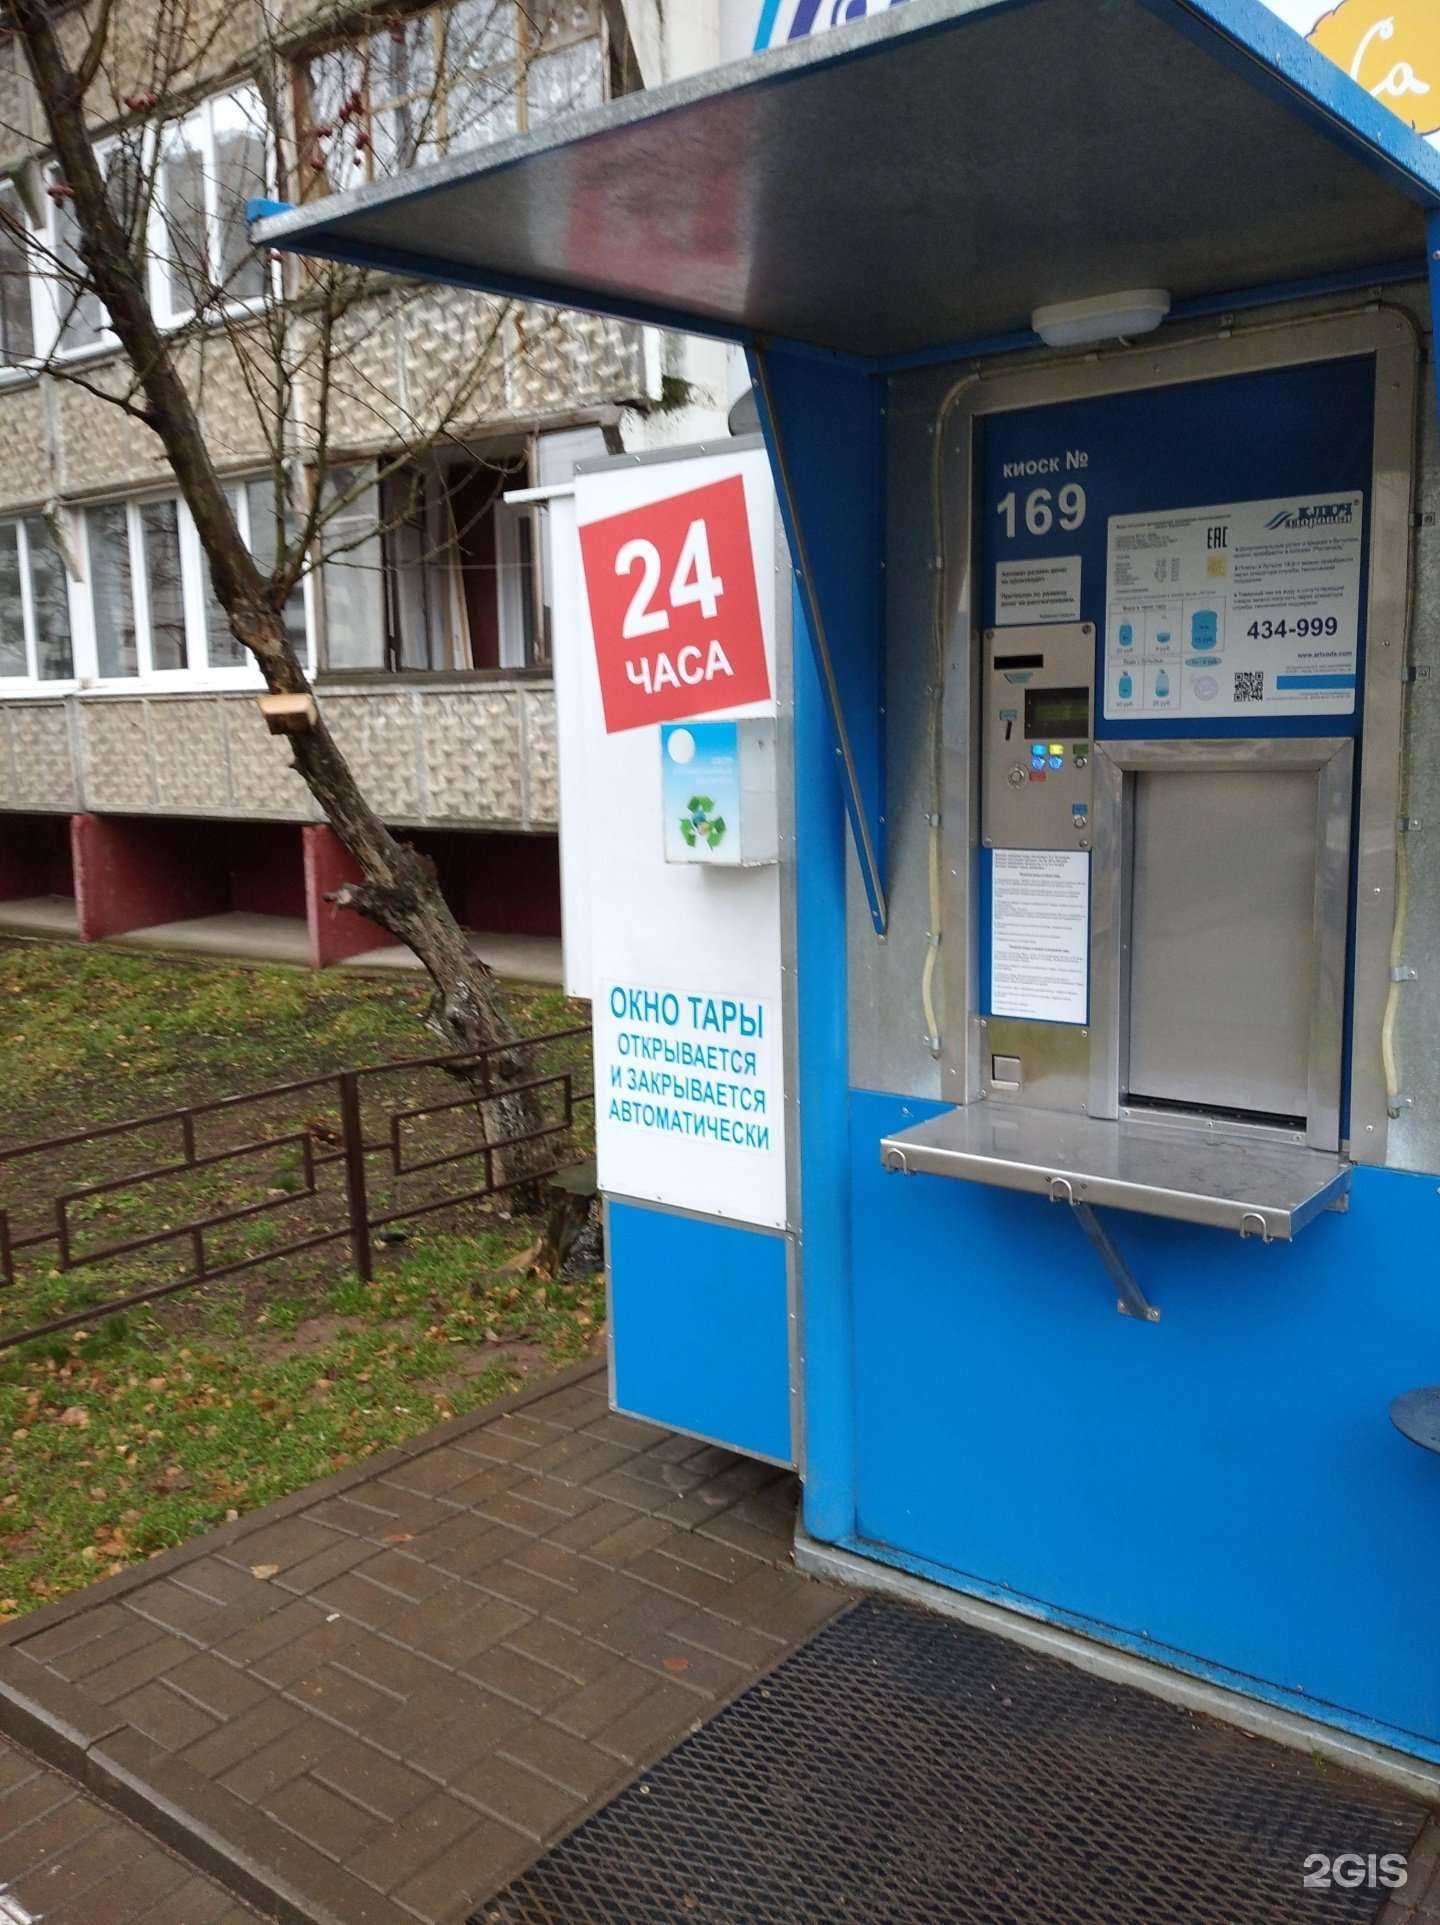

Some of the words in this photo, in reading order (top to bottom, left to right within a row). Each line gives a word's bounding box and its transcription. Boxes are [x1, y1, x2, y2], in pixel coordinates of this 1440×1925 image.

[1066, 449, 1088, 470] №
[997, 483, 1086, 538] 169
[615, 518, 724, 640] 24
[1247, 617, 1338, 640] 434-999
[625, 640, 735, 695] ЧАСА
[611, 986, 680, 1026] ОКНО
[687, 996, 763, 1039] ТАРЫ
[618, 1033, 757, 1076] ОТКРЫВАЕТСЯ
[611, 1064, 622, 1088] И
[627, 1068, 766, 1114] ЗАКРЫВАЕТСЯ
[609, 1098, 769, 1151] АВТОМАТИЧЕСКИ
